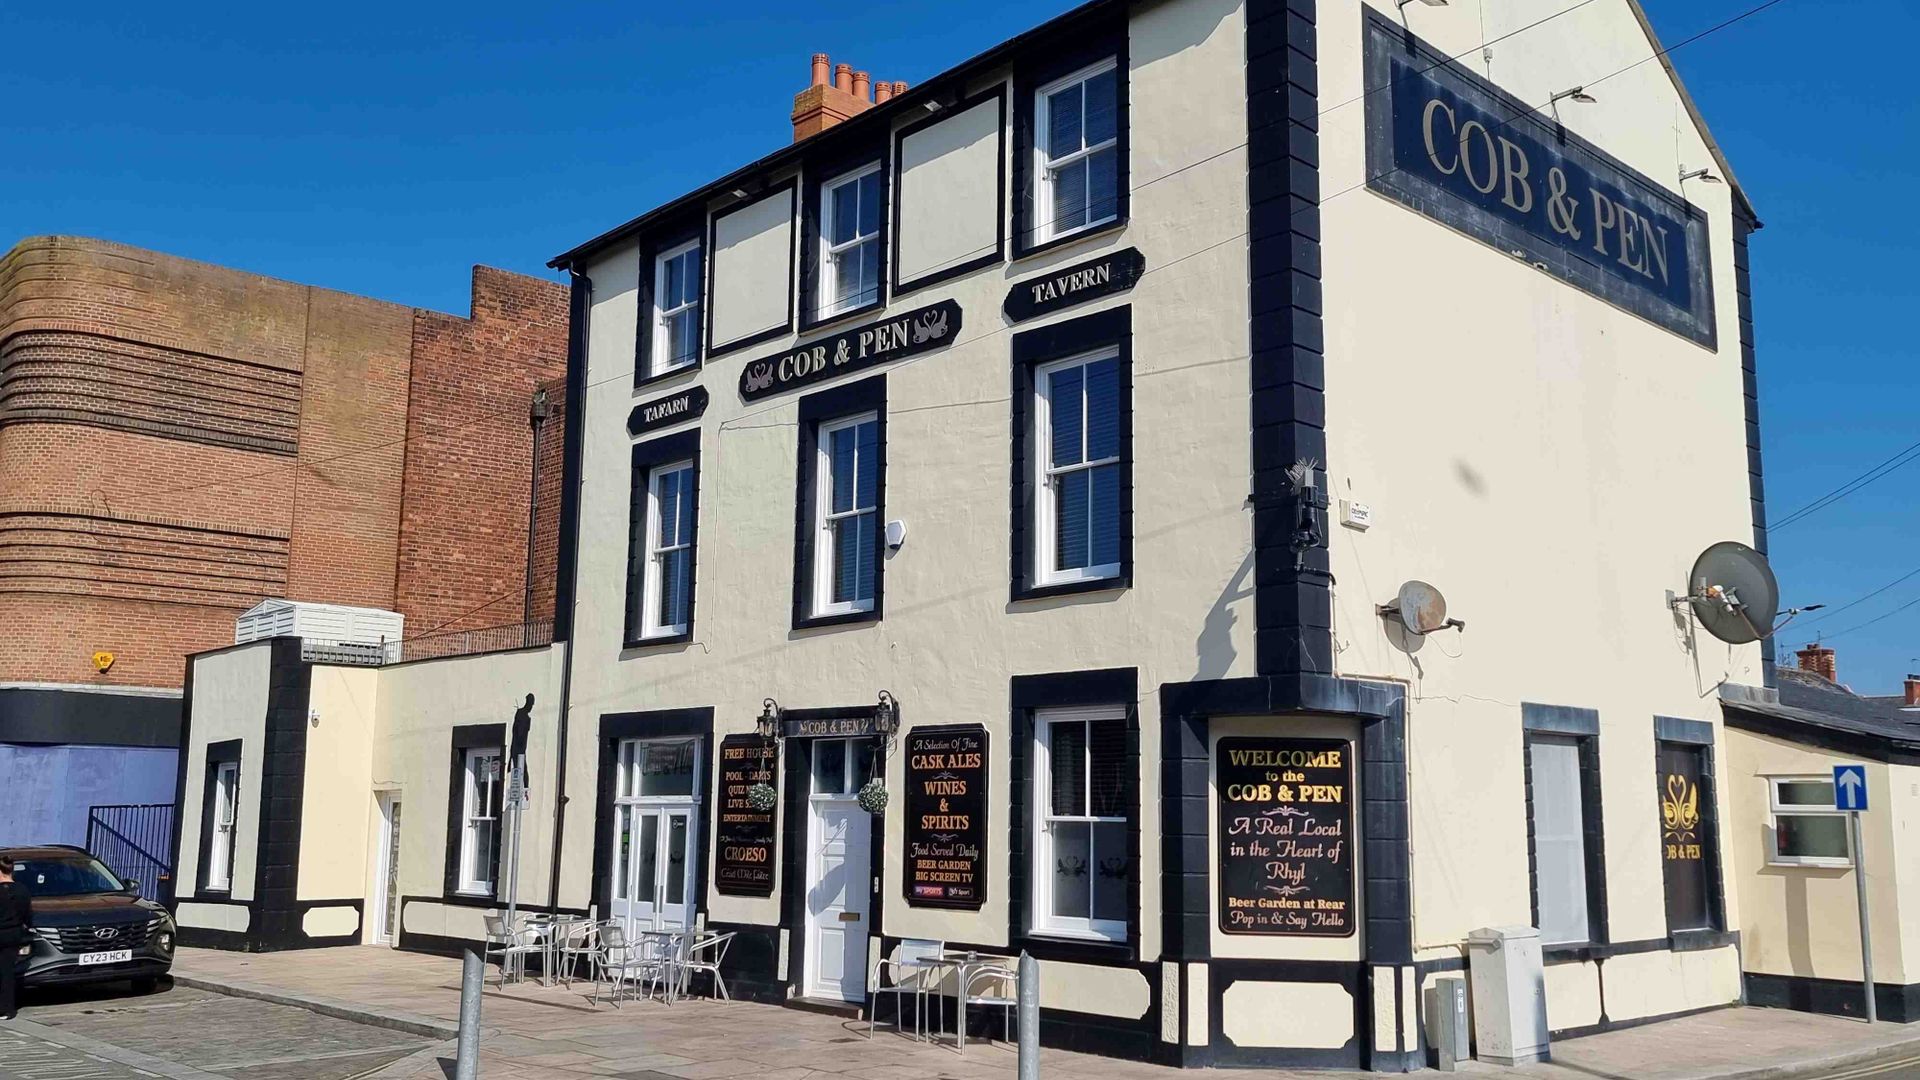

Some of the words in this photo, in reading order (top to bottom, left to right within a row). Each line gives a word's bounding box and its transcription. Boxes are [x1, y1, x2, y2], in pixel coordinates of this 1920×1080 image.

[1422, 99, 1533, 213] COB
[1547, 167, 1582, 241] &
[1589, 187, 1668, 287] PEN
[1031, 262, 1111, 304] TAVERN
[778, 346, 826, 382] COB
[833, 338, 851, 366] &
[858, 318, 910, 359] PEN
[643, 395, 690, 423] TAFARN
[808, 721, 828, 734] COB
[829, 720, 838, 733] &
[840, 719, 860, 732] PEN
[913, 739, 923, 751] A
[924, 738, 950, 750] Selection
[961, 737, 979, 751] Fine
[724, 748, 745, 760] FREE
[911, 754, 945, 770] CASK
[947, 753, 981, 769] ALES
[1229, 750, 1342, 768] WELCOME
[725, 771, 744, 781] POOL
[1265, 771, 1279, 782] to
[1282, 770, 1305, 782] the
[728, 785, 746, 797] QUIZ
[924, 780, 967, 796] WINES
[1227, 784, 1272, 802] COB
[1277, 784, 1294, 802] &
[1298, 785, 1343, 803] PEN
[727, 799, 744, 808] LIVE
[939, 797, 950, 813] &
[723, 814, 771, 823] ENTERTAINMENT
[921, 815, 969, 830] SPIRITS
[1228, 816, 1251, 835] A
[1254, 817, 1294, 835] Real
[1298, 817, 1342, 837] Local
[724, 846, 767, 863] CROESO
[910, 842, 929, 858] Food
[930, 843, 955, 856] Served
[956, 843, 979, 861] Daily
[1230, 842, 1245, 856] in
[1249, 840, 1271, 857] the
[1276, 840, 1324, 859] Heart
[1327, 840, 1344, 864] of
[917, 860, 936, 869] BEER
[938, 860, 971, 870] GARDEN
[915, 871, 928, 881] BIG
[930, 872, 960, 882] SCREEN
[961, 873, 974, 883] TV
[1265, 861, 1305, 886] Rhyl
[1228, 897, 1256, 908] Beer
[1258, 898, 1301, 909] Garden
[1303, 899, 1315, 909] at
[1317, 899, 1345, 910] Rear
[1230, 910, 1254, 929] Pop
[1257, 913, 1268, 924] in
[1271, 912, 1283, 925] &
[1286, 911, 1307, 930] Say
[1311, 912, 1344, 926] Hello
[83, 953, 108, 963] CY23
[109, 951, 127, 960] HCK
